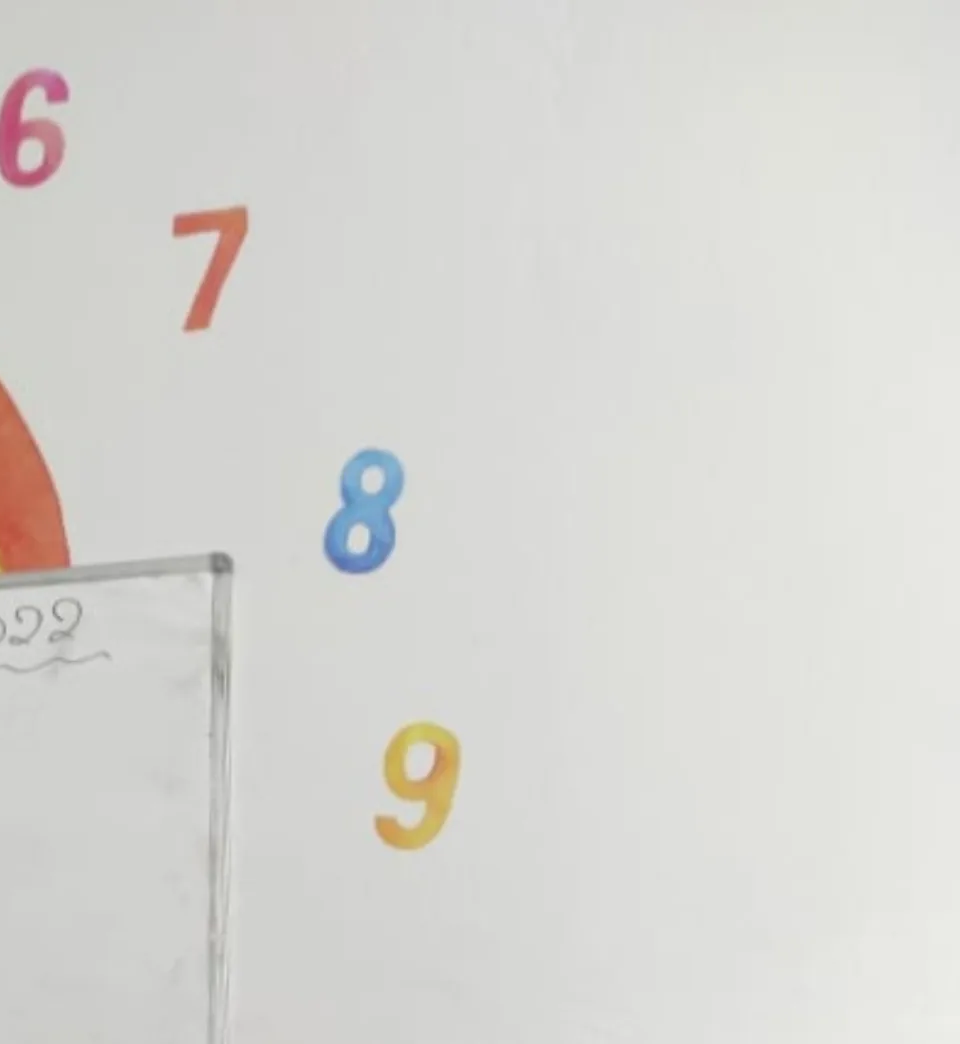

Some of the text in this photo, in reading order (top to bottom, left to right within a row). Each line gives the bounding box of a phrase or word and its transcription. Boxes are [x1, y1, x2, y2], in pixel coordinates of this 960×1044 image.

[173, 207, 247, 331] 7
[324, 450, 403, 574] 8
[376, 723, 459, 849] 9
